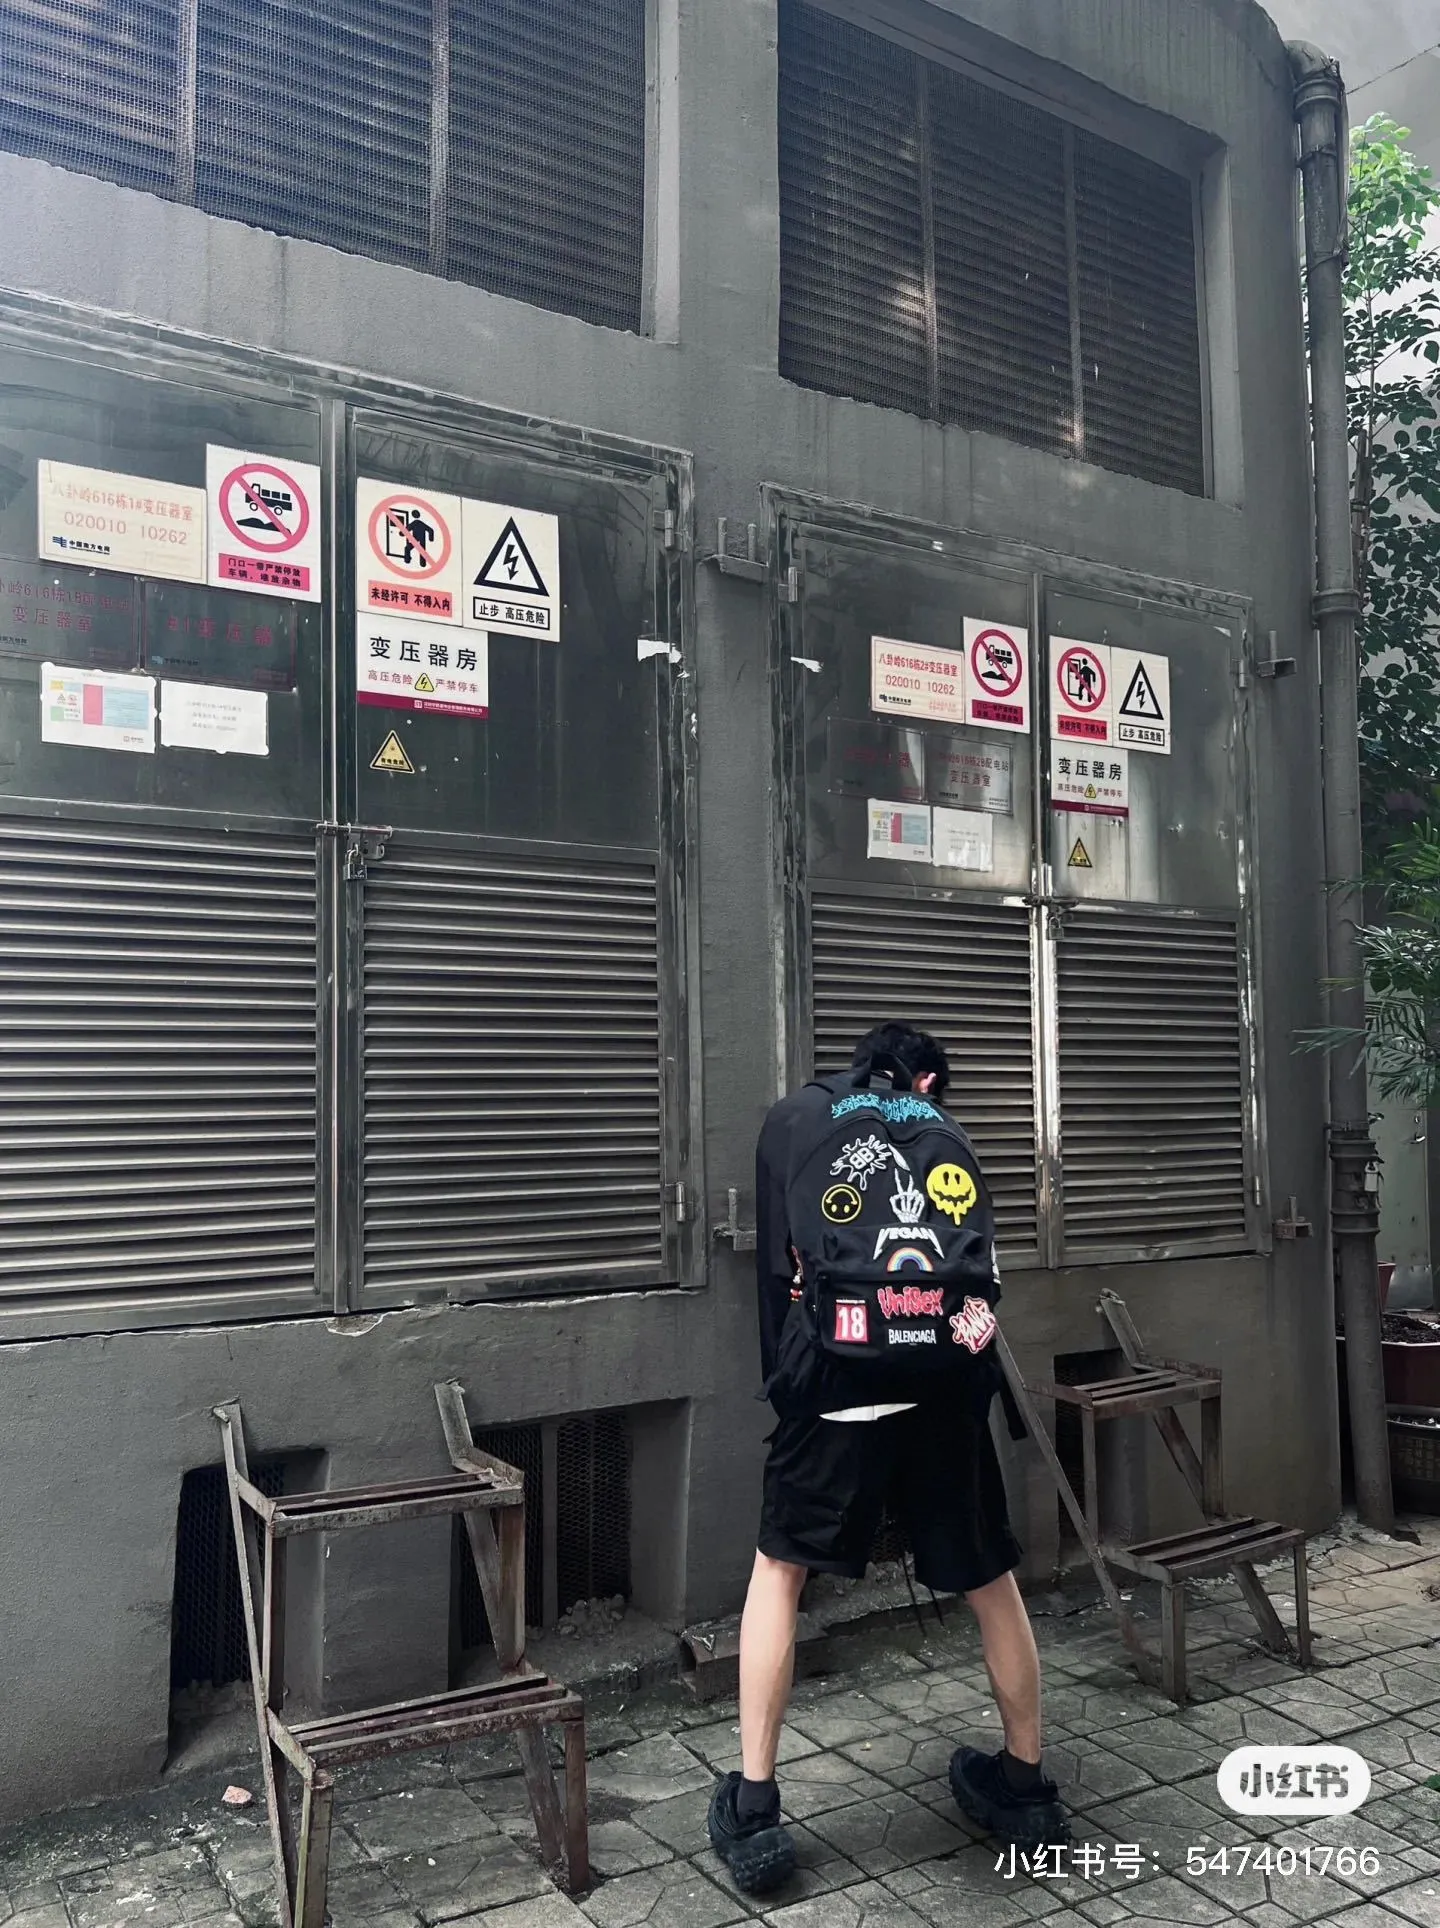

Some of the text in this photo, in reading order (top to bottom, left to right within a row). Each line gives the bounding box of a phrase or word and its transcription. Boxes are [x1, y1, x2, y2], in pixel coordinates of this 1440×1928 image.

[52, 480, 194, 522] 八卦岭616栋1#变压器室
[63, 510, 188, 547] 020010 10262
[370, 587, 451, 612] 未经许可 不得入内
[478, 603, 545, 625] 止步 高压危险
[369, 636, 478, 672] 变压器房
[878, 652, 958, 677] 八卦岭616栋2#变压器室
[367, 669, 479, 694] 高压危险 严禁停车
[885, 674, 955, 696] 020010 10262
[1122, 727, 1162, 743] 止步 高压危险
[1058, 757, 1122, 780] 变压器房
[838, 1307, 864, 1340] 18
[888, 1329, 937, 1345] BALENCIAGA
